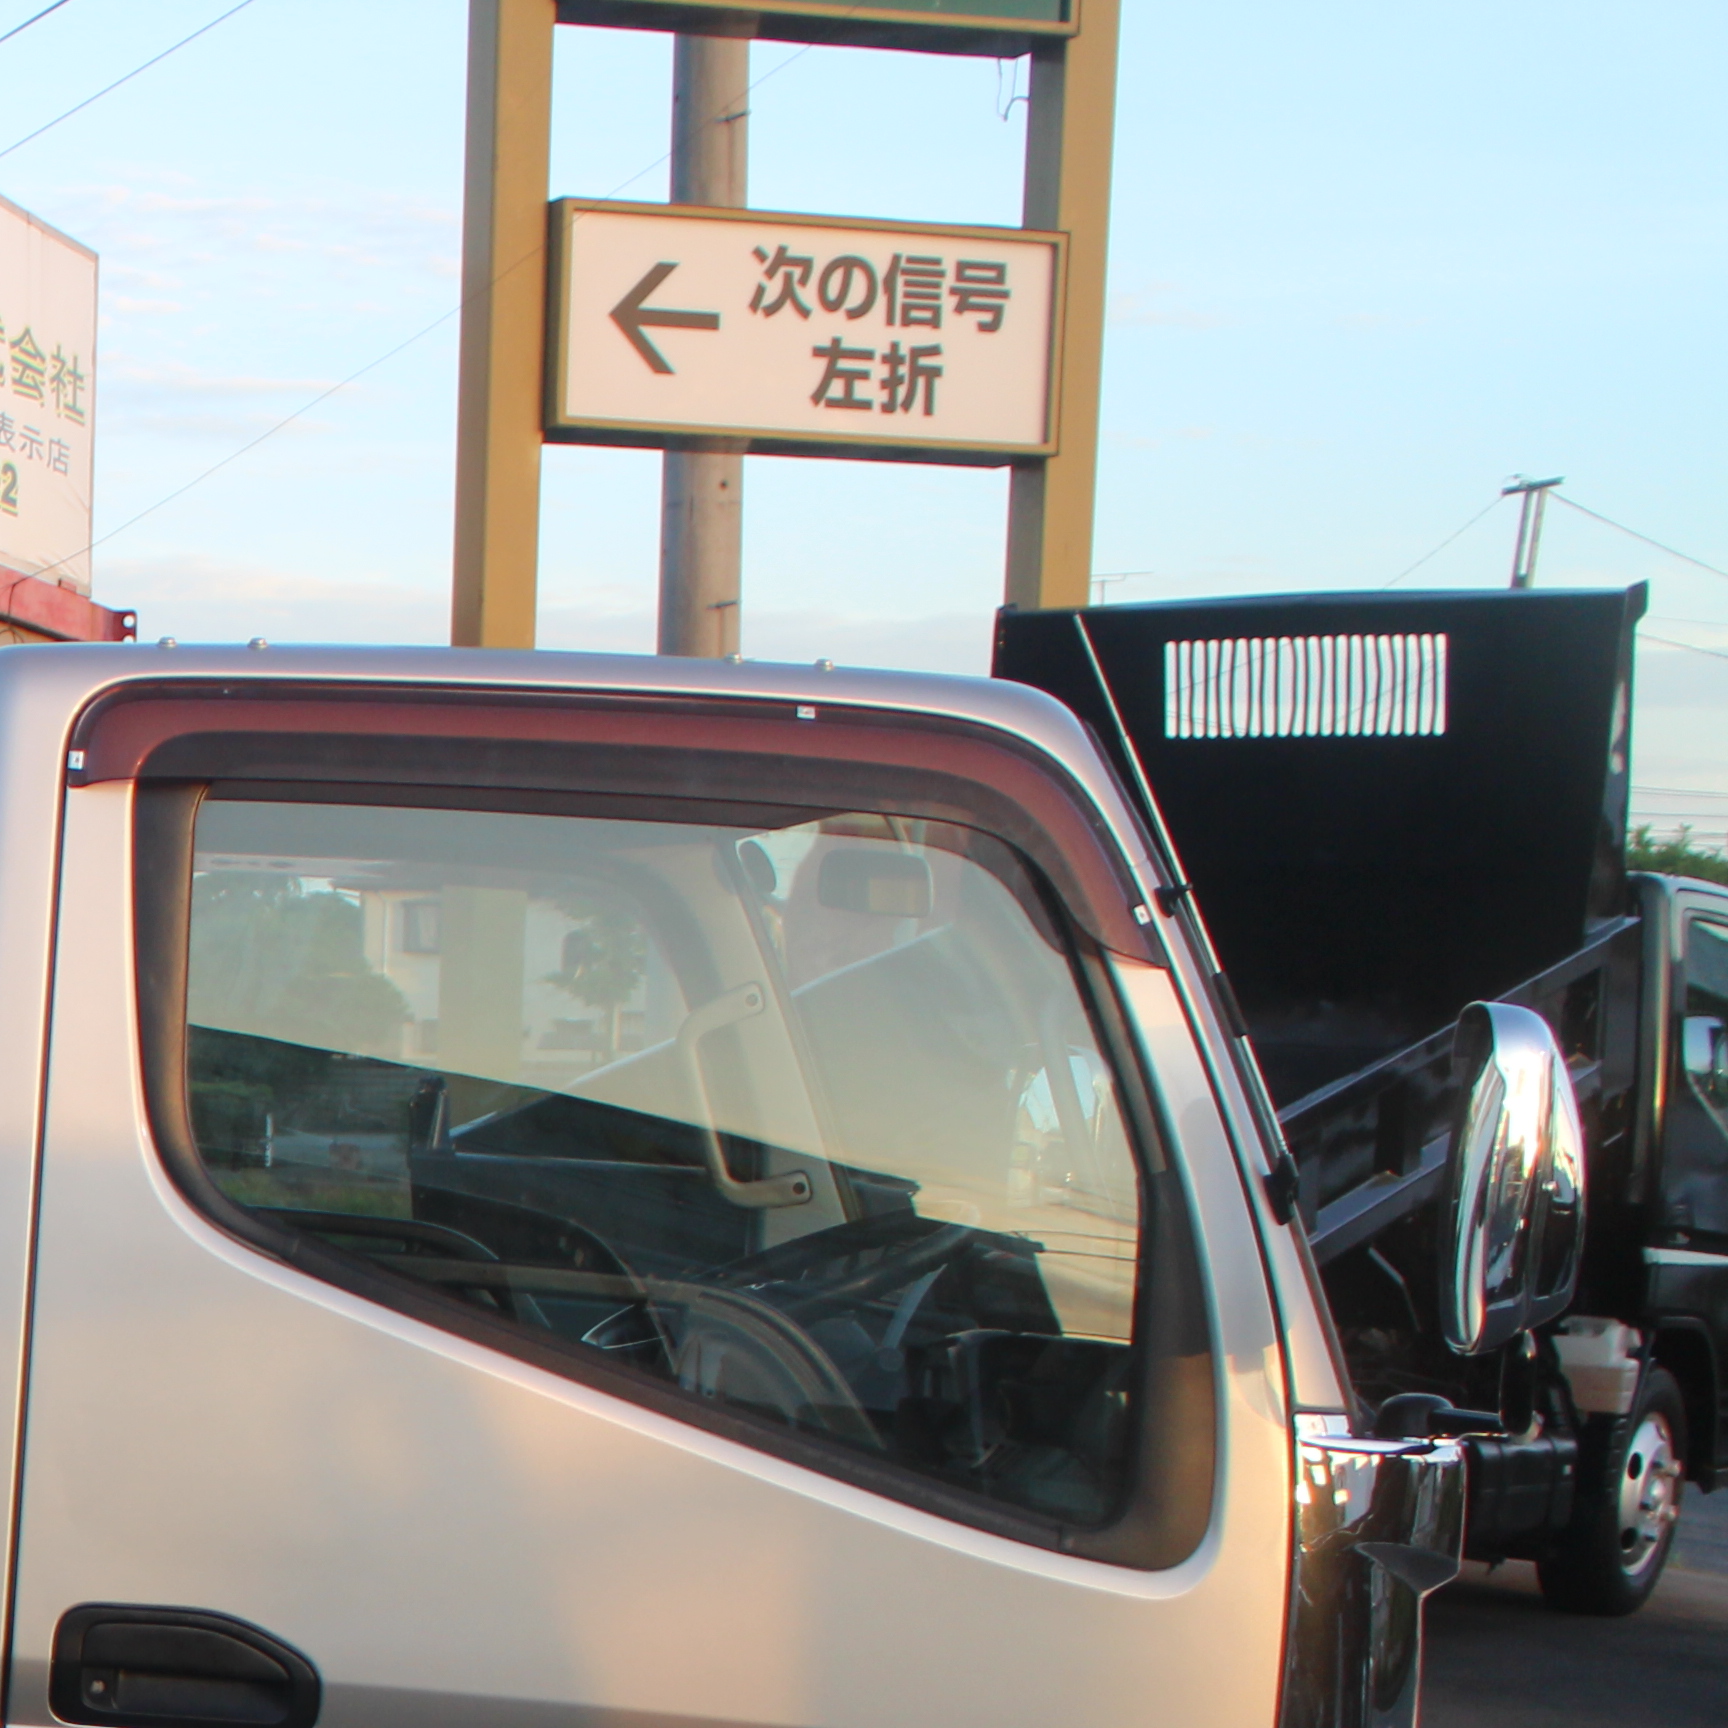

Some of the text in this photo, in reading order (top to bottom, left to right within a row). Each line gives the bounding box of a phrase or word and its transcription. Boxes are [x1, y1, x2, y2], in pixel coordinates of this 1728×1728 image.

[748, 244, 1012, 333] 次の信号
[810, 336, 944, 417] 左折
